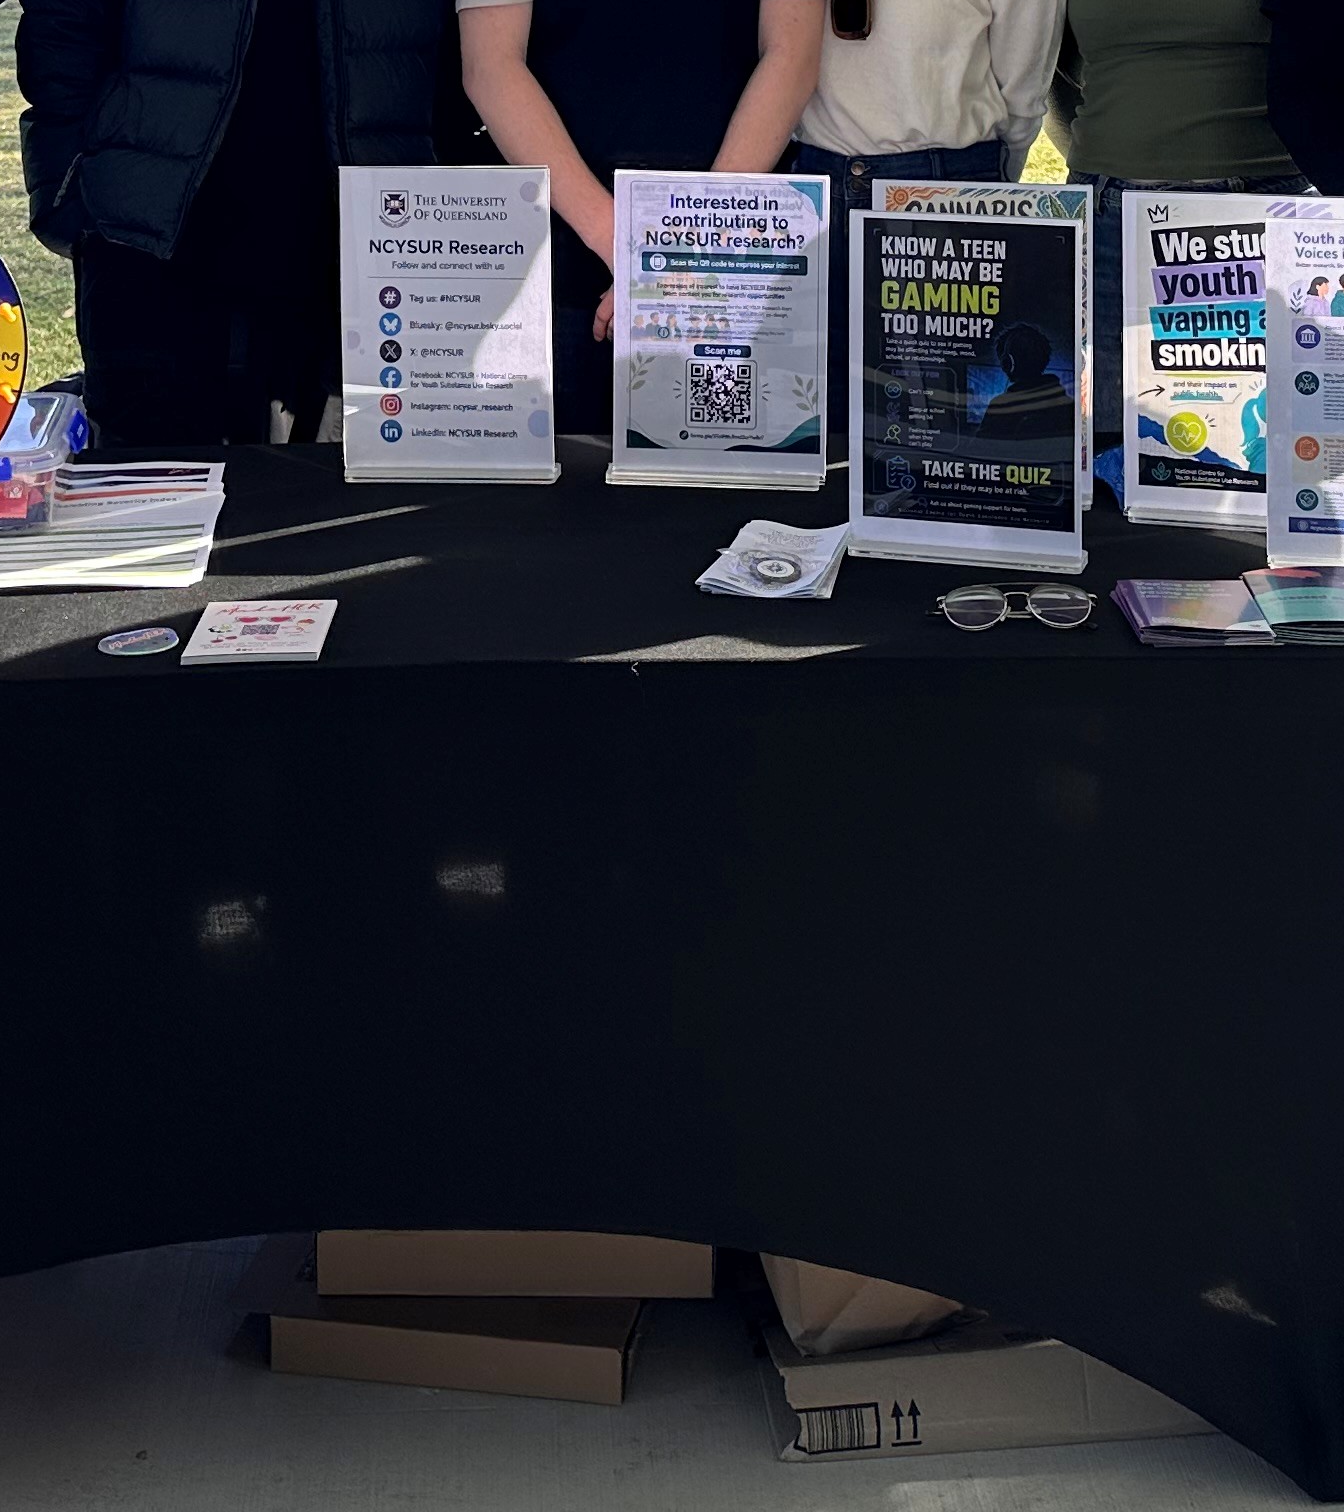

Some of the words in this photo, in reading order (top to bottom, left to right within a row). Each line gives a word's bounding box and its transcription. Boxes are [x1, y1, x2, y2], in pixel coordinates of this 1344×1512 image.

[670, 194, 759, 210] Interested
[763, 195, 778, 211] in
[905, 200, 1032, 216] CANNABIS
[662, 213, 767, 232] contributing
[772, 216, 788, 229] to
[646, 231, 722, 247] NCYSUR
[726, 234, 805, 249] research?
[1294, 232, 1334, 244] Youth
[369, 240, 443, 254] NCYSUR
[449, 240, 524, 254] Research
[881, 236, 936, 257] KNOW
[942, 239, 955, 257] A
[961, 239, 1006, 260] TEEN
[1158, 232, 1206, 263] We
[1295, 247, 1338, 259] Voices
[392, 260, 419, 270] Follow
[421, 261, 437, 270] and
[439, 262, 472, 270] connect
[475, 262, 492, 270] with
[881, 258, 926, 279] WHO
[931, 260, 974, 281] MAY
[979, 262, 1003, 283] BE
[1159, 264, 1257, 304] youth
[409, 295, 424, 304] Tag
[440, 294, 480, 303] #NCYSUR
[881, 280, 1000, 315] GAMING
[881, 313, 918, 334] TOO
[925, 315, 994, 338] MUCH?
[1158, 304, 1250, 337] vaping
[421, 348, 464, 357] @NCYSUR
[704, 346, 726, 355] Scan
[1159, 338, 1266, 366] smokin
[411, 402, 451, 412] Instagram:
[453, 404, 513, 413] ncysur_research
[448, 429, 482, 437] NCYSUR
[484, 430, 518, 438] Research
[922, 460, 965, 478] TAKE
[969, 464, 1001, 481] THE
[1006, 465, 1052, 485] QUIZ
[954, 482, 959, 490] if
[961, 484, 976, 492] they
[994, 486, 1003, 494] be
